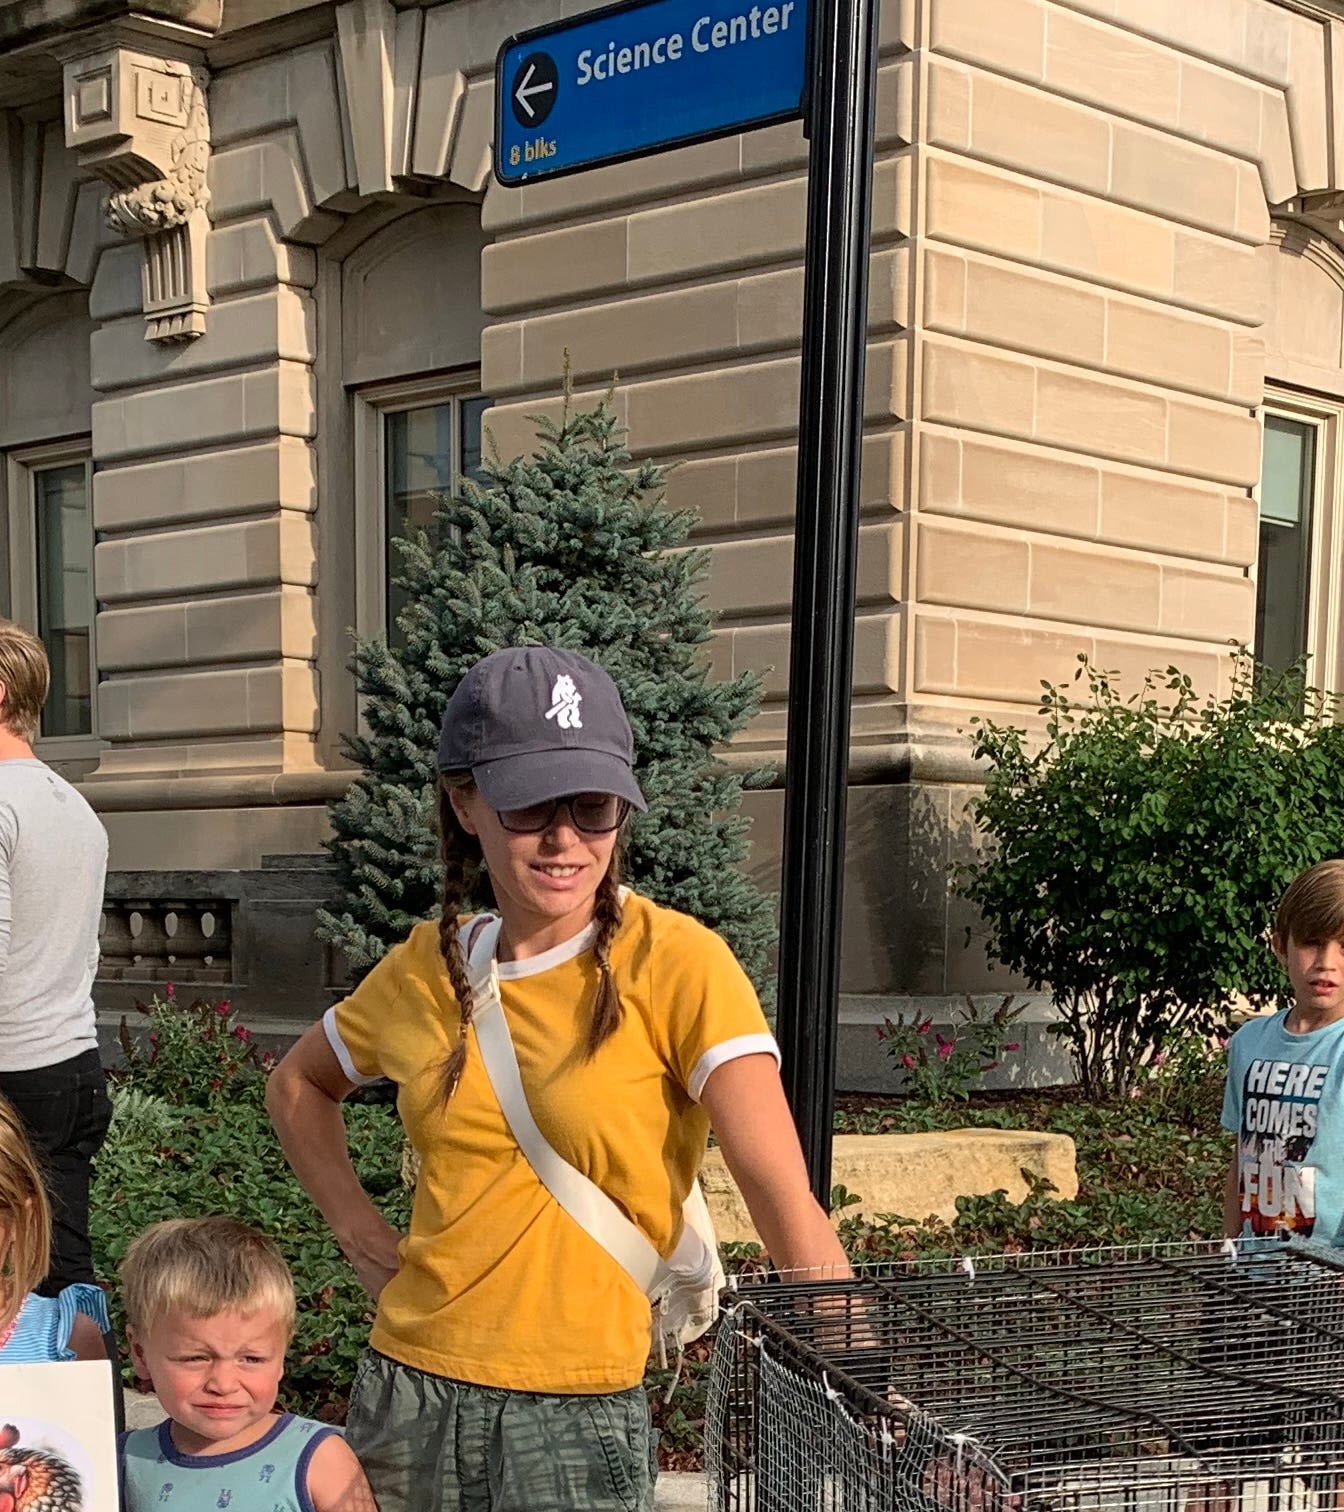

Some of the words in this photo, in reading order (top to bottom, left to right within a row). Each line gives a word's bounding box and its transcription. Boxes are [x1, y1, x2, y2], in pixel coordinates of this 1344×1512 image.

[576, 35, 682, 86] Science
[691, 1, 794, 53] Center
[509, 144, 520, 165] 8
[524, 136, 557, 162] blks
[1247, 1060, 1329, 1098] HERE
[1246, 1097, 1318, 1139] COMES
[1242, 1160, 1317, 1219] FUN
